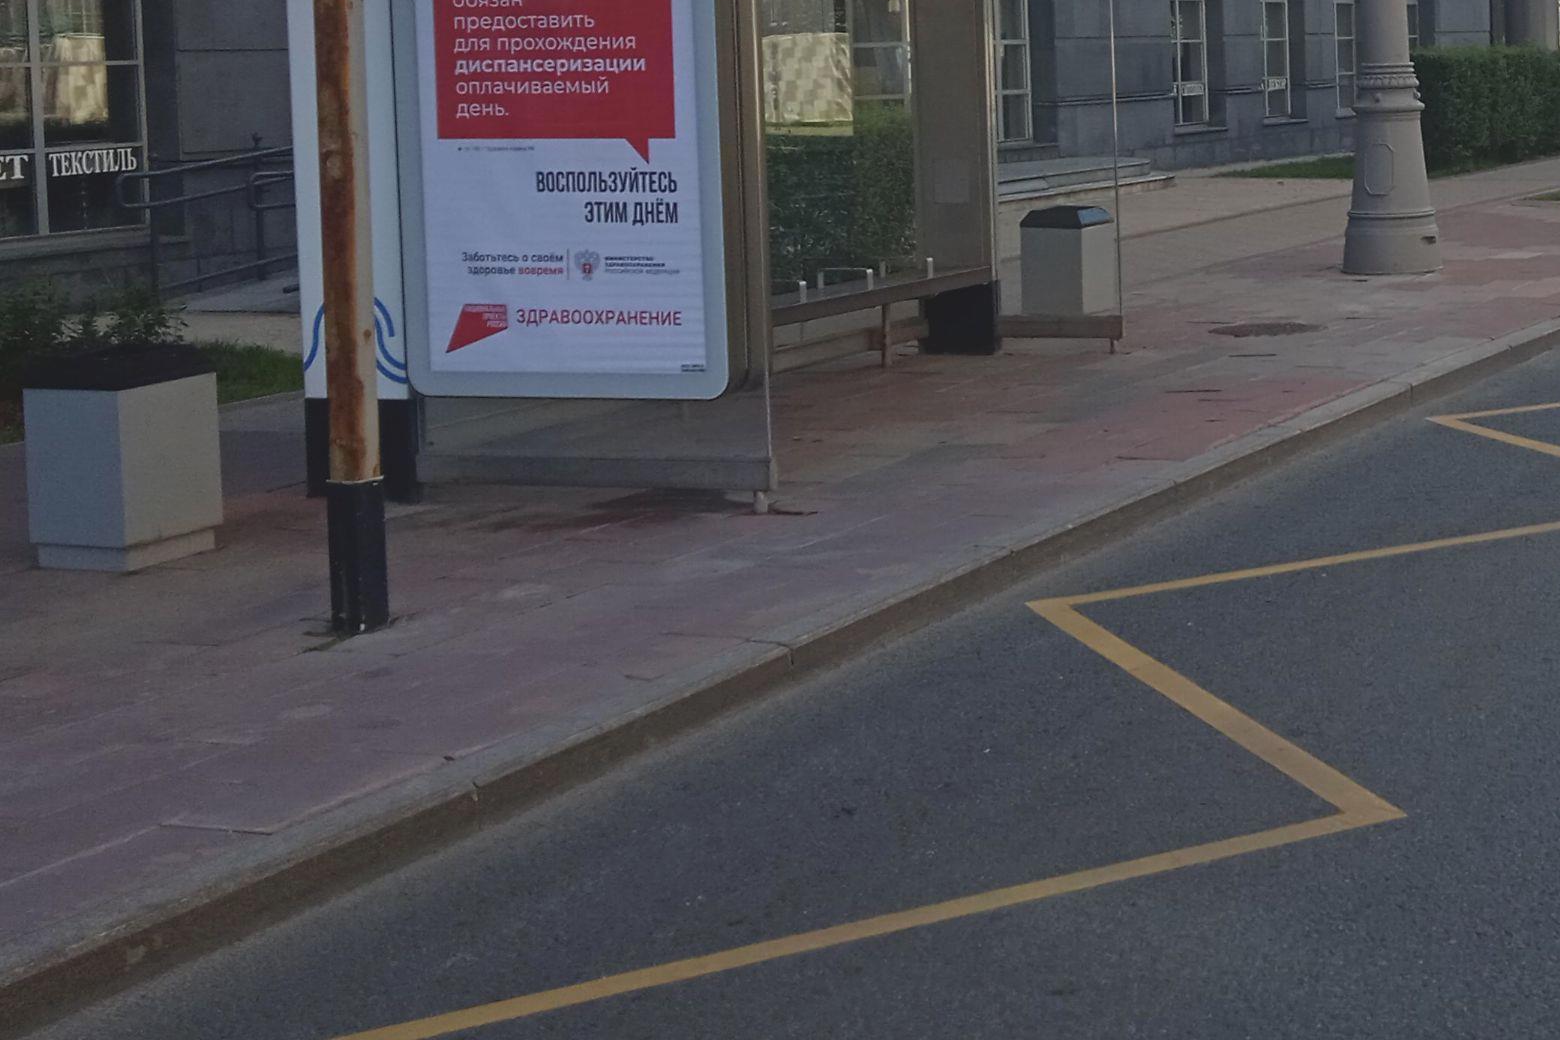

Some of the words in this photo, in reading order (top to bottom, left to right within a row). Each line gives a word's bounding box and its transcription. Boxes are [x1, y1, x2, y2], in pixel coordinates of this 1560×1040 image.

[453, 13, 596, 33] предоставить
[454, 37, 490, 54] для
[497, 33, 637, 54] прохождения
[454, 57, 647, 76] диспансеризации
[455, 76, 610, 95] оплачиваемый
[456, 102, 509, 119] день.
[49, 147, 138, 177] ТЕКСТИЛЬ
[535, 166, 678, 194] ВОСПОЛЬЗУЙТЕСЬ
[584, 201, 628, 224] ЭТИМ
[632, 197, 679, 226] ДНЁМ
[521, 254, 529, 262] о
[516, 308, 682, 327] ЗДРАВООХРАНЕНИЕ
